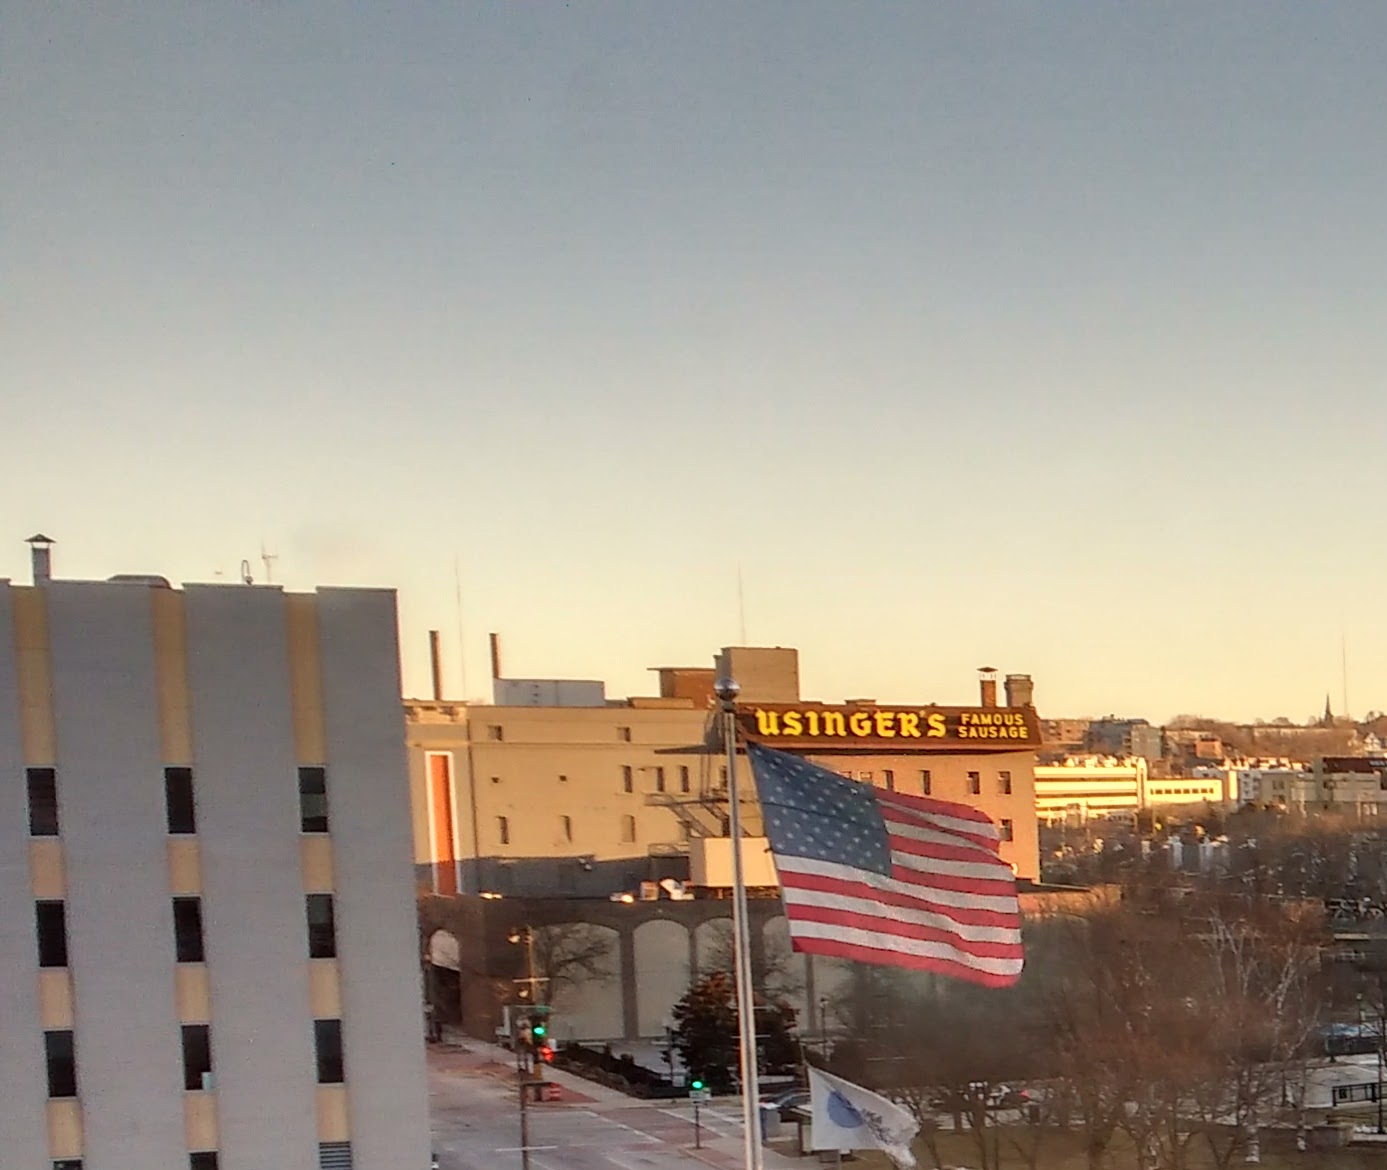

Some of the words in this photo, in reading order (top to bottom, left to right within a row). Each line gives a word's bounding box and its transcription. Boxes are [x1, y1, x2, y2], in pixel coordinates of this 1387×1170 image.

[755, 708, 947, 738] USINGER'S
[960, 712, 1024, 726] FAMOUS
[957, 725, 1029, 739] SAUSAGE
